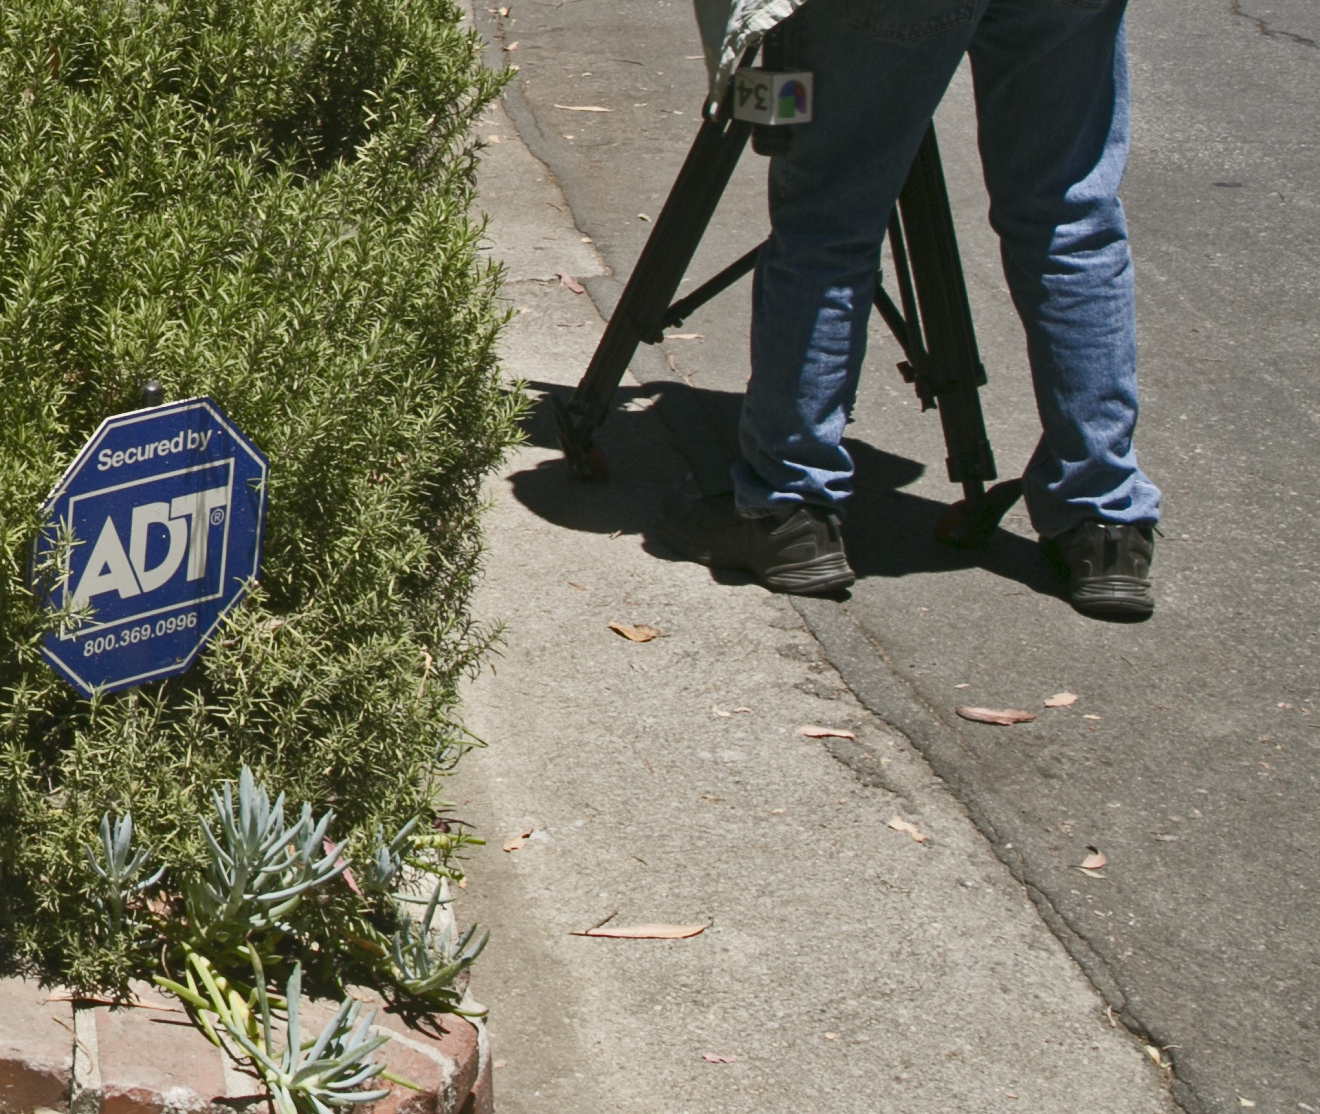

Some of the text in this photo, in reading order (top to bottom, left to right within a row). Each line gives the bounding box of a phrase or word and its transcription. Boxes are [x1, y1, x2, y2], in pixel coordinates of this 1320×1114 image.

[738, 80, 768, 111] 34
[97, 429, 213, 471] Secured by
[63, 486, 229, 612] ADT
[83, 612, 198, 657] 800.369.0996
